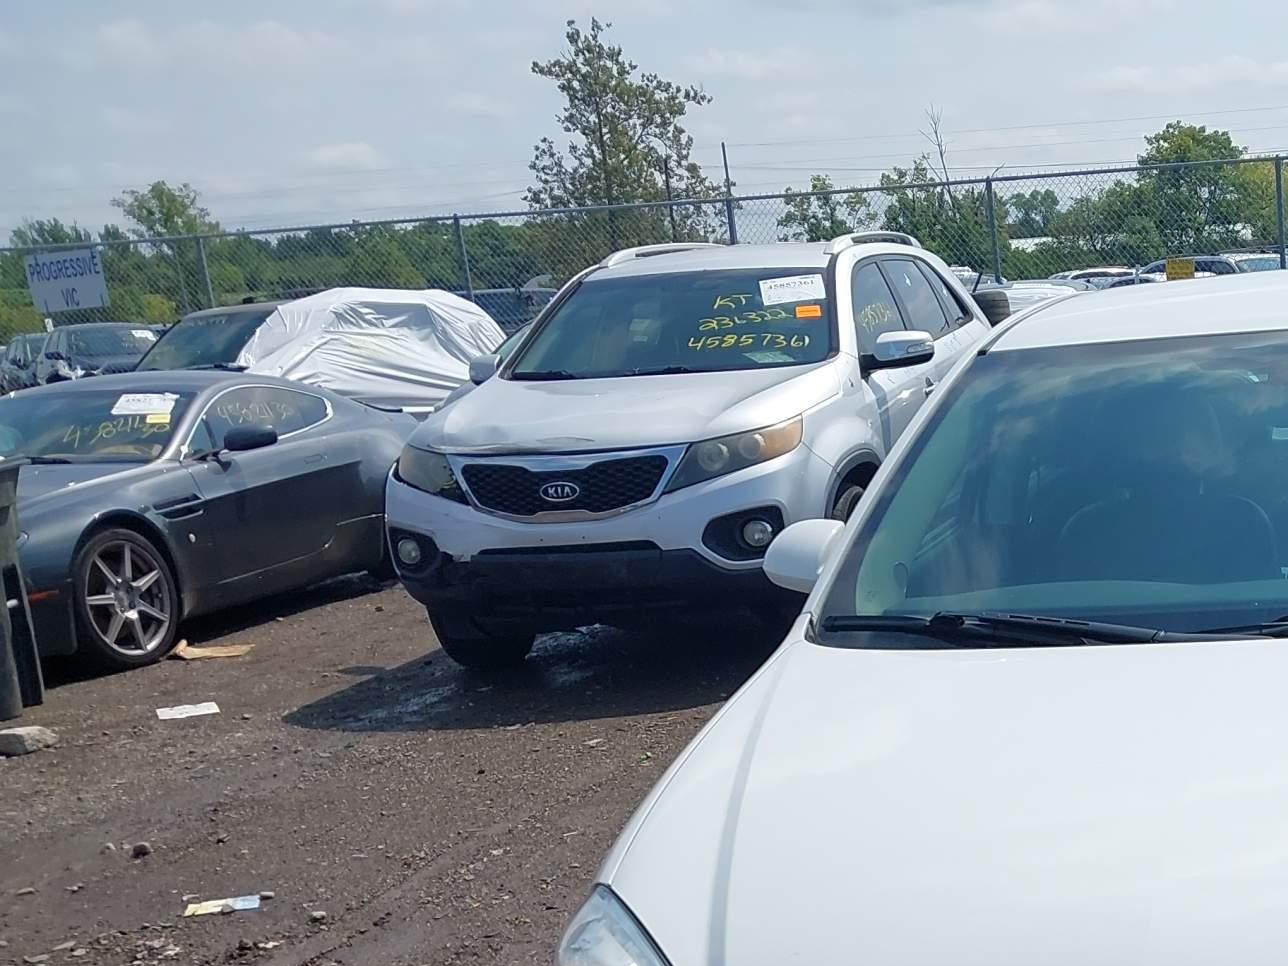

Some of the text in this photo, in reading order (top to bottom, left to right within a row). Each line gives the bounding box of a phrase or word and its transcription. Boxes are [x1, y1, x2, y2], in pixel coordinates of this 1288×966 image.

[28, 254, 100, 283] PROGRESSIVE
[61, 287, 81, 308] VIC
[687, 333, 810, 350] 45857361
[547, 486, 572, 497] KIA
